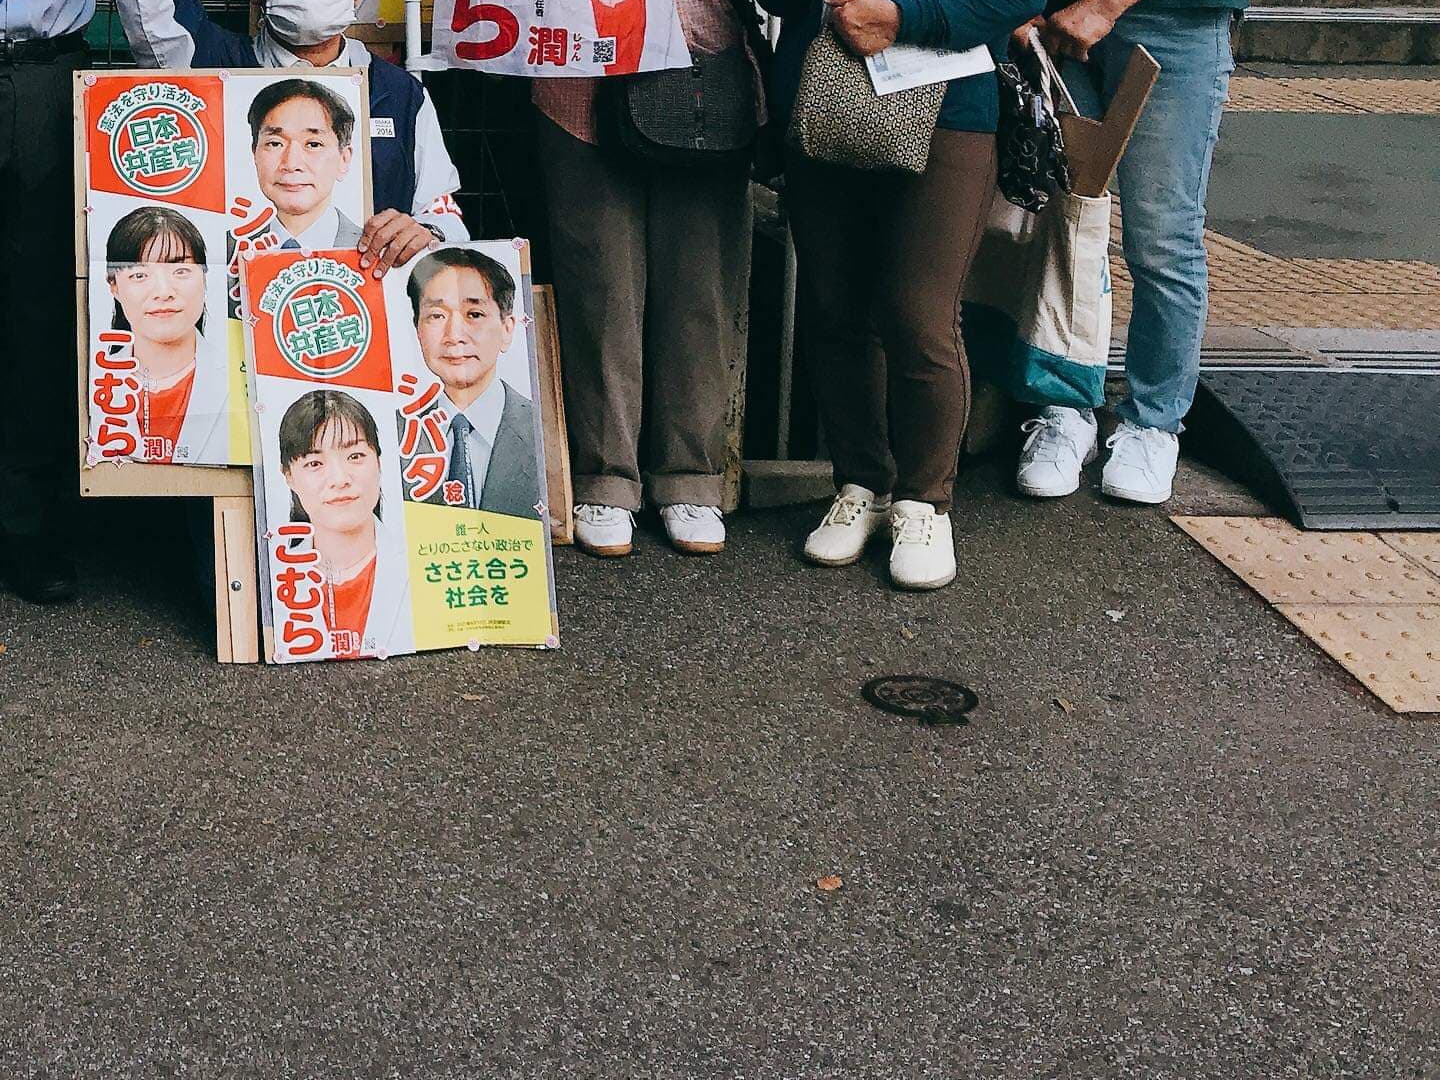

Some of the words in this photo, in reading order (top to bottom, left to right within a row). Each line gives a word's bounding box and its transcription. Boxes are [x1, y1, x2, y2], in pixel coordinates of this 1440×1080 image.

[527, 26, 568, 66] 潤
[571, 32, 582, 62] じゅん
[100, 85, 204, 132] 憲法を守り活かす
[130, 115, 179, 148] 日本
[124, 139, 200, 179] 共産党
[261, 260, 364, 313] 憲法を守り活かす
[291, 291, 342, 327] 日本
[289, 316, 365, 361] 共産党
[93, 333, 140, 458] こむら
[143, 438, 163, 458] 潤
[397, 373, 449, 498] シバタ
[445, 482, 464, 503] 稔
[455, 522, 490, 537] 誰一人
[417, 539, 534, 557] とりのこさない政治で
[424, 557, 529, 583] ささえ合う
[275, 525, 324, 656] こむら
[445, 584, 509, 610] 社会を
[330, 632, 351, 653] 潤
